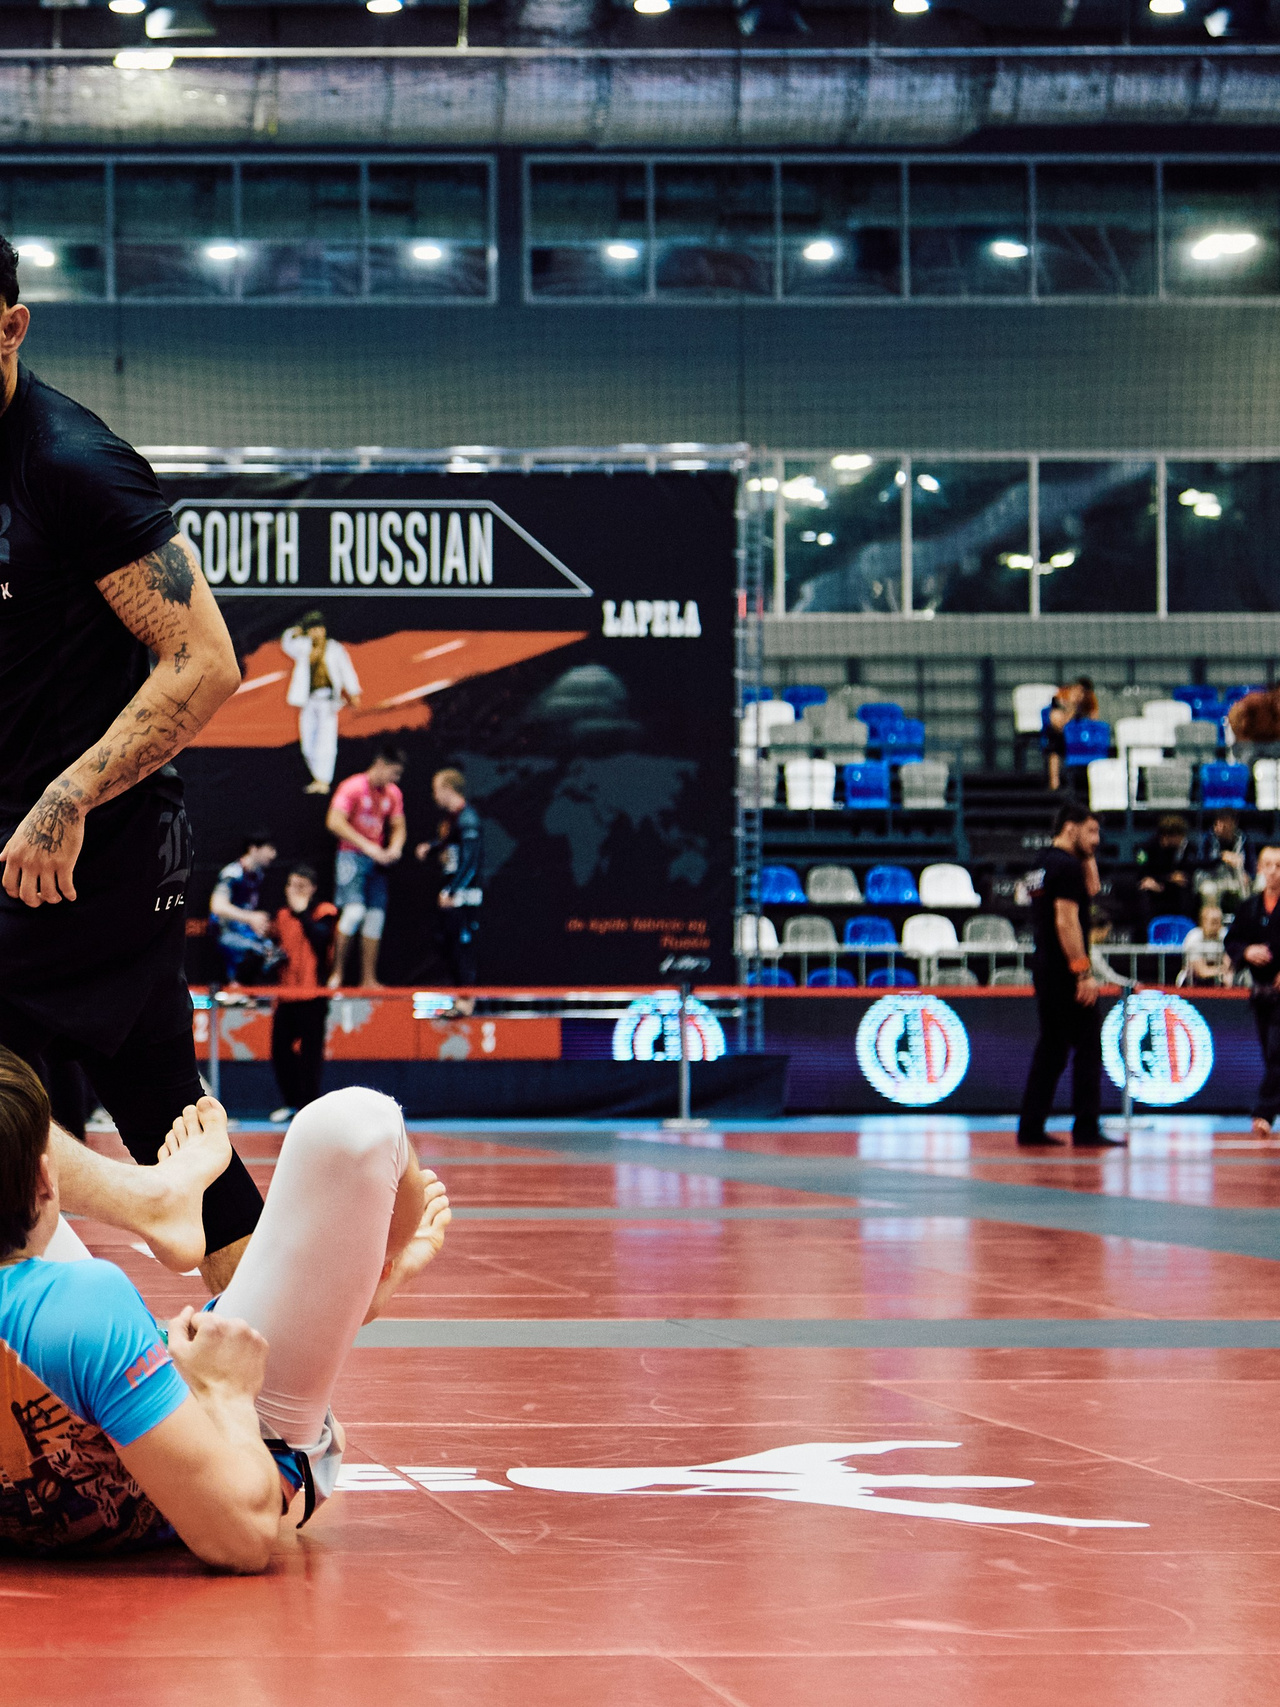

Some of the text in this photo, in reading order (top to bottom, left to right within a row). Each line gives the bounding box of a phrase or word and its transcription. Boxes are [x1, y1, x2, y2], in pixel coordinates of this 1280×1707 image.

[178, 510, 494, 585] SOUTH RUSSIAN
[602, 599, 702, 638] LAPELA
[124, 1338, 168, 1390] MAN
